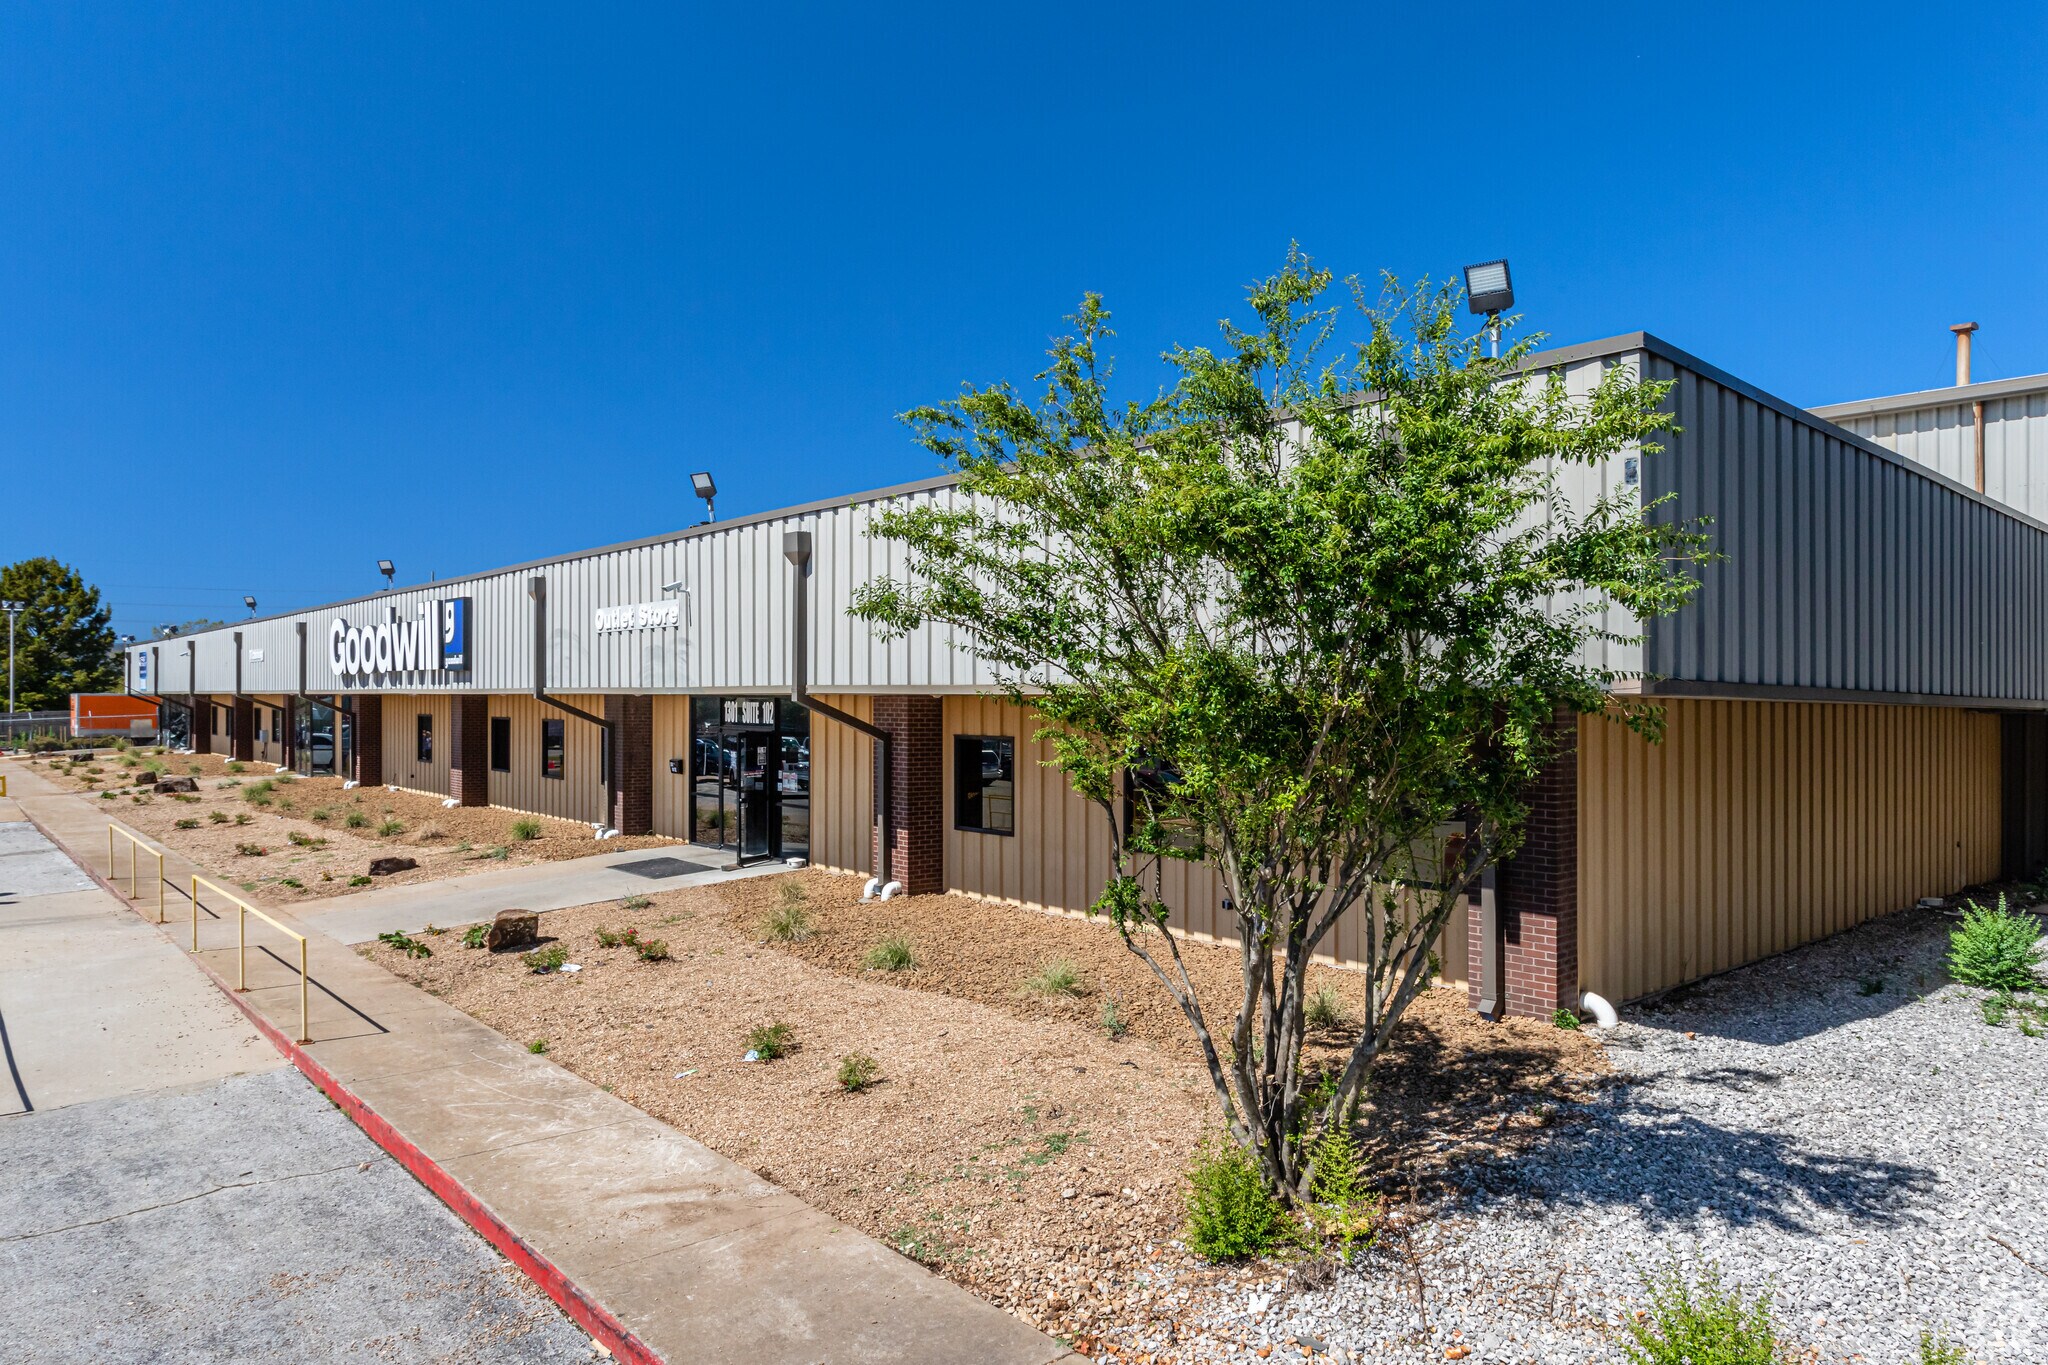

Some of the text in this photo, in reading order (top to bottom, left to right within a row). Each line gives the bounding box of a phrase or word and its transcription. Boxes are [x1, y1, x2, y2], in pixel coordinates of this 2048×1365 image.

[595, 603, 679, 631] Outlet Store
[330, 600, 439, 675] Goodwill
[724, 701, 774, 724] 1301 SUITE 102
